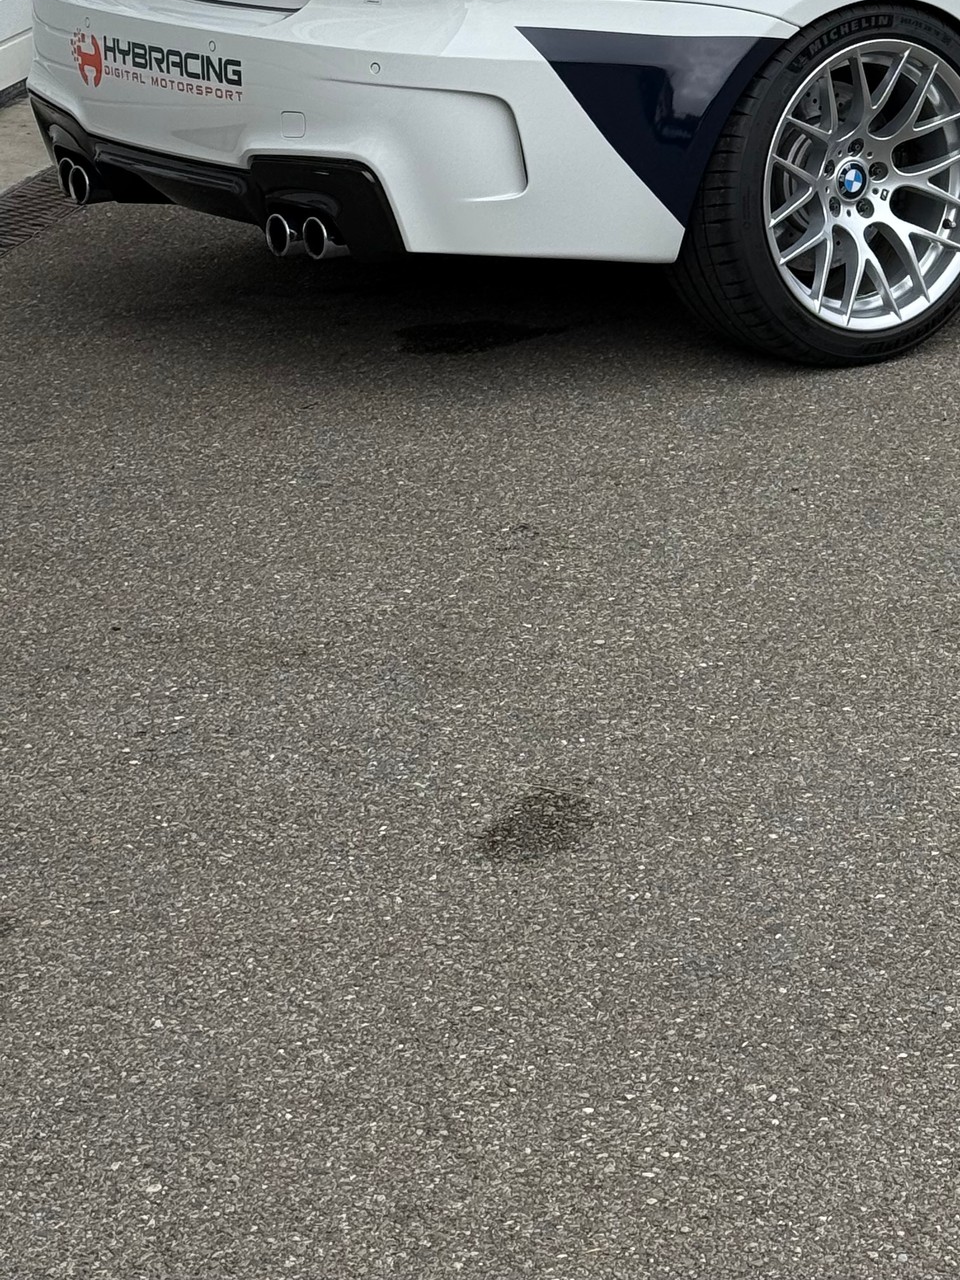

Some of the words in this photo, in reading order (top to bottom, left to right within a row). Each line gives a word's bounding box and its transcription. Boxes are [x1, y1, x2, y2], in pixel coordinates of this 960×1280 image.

[808, 15, 889, 55] MICHELIN
[103, 35, 242, 87] HYBRACING
[104, 65, 146, 85] DIGITAL
[151, 76, 243, 102] MOTORSPORT
